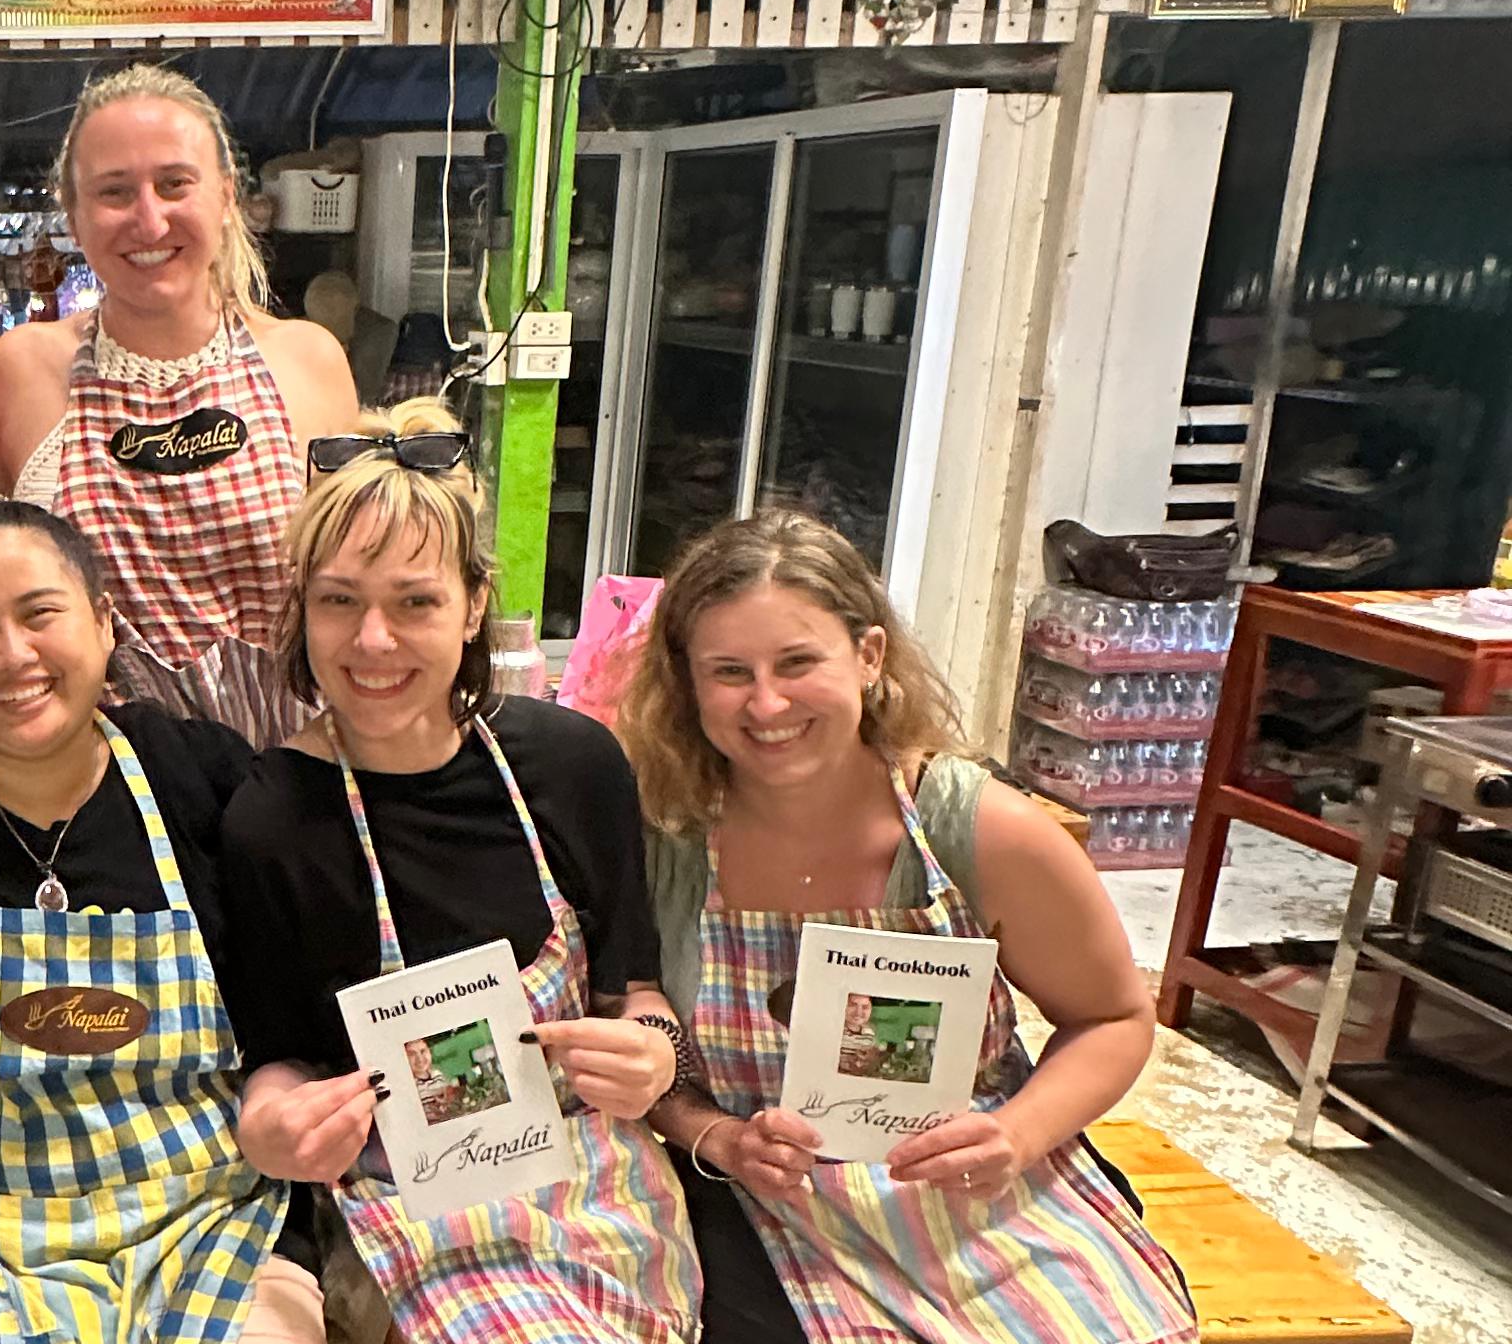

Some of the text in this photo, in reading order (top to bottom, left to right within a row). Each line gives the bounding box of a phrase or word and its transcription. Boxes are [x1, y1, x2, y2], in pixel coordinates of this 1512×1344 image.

[826, 949, 971, 978] Thai Cookbook
[366, 973, 500, 1024] Thai Cookbook
[57, 1006, 131, 1034] Napalai
[456, 1123, 551, 1170] Napalai
